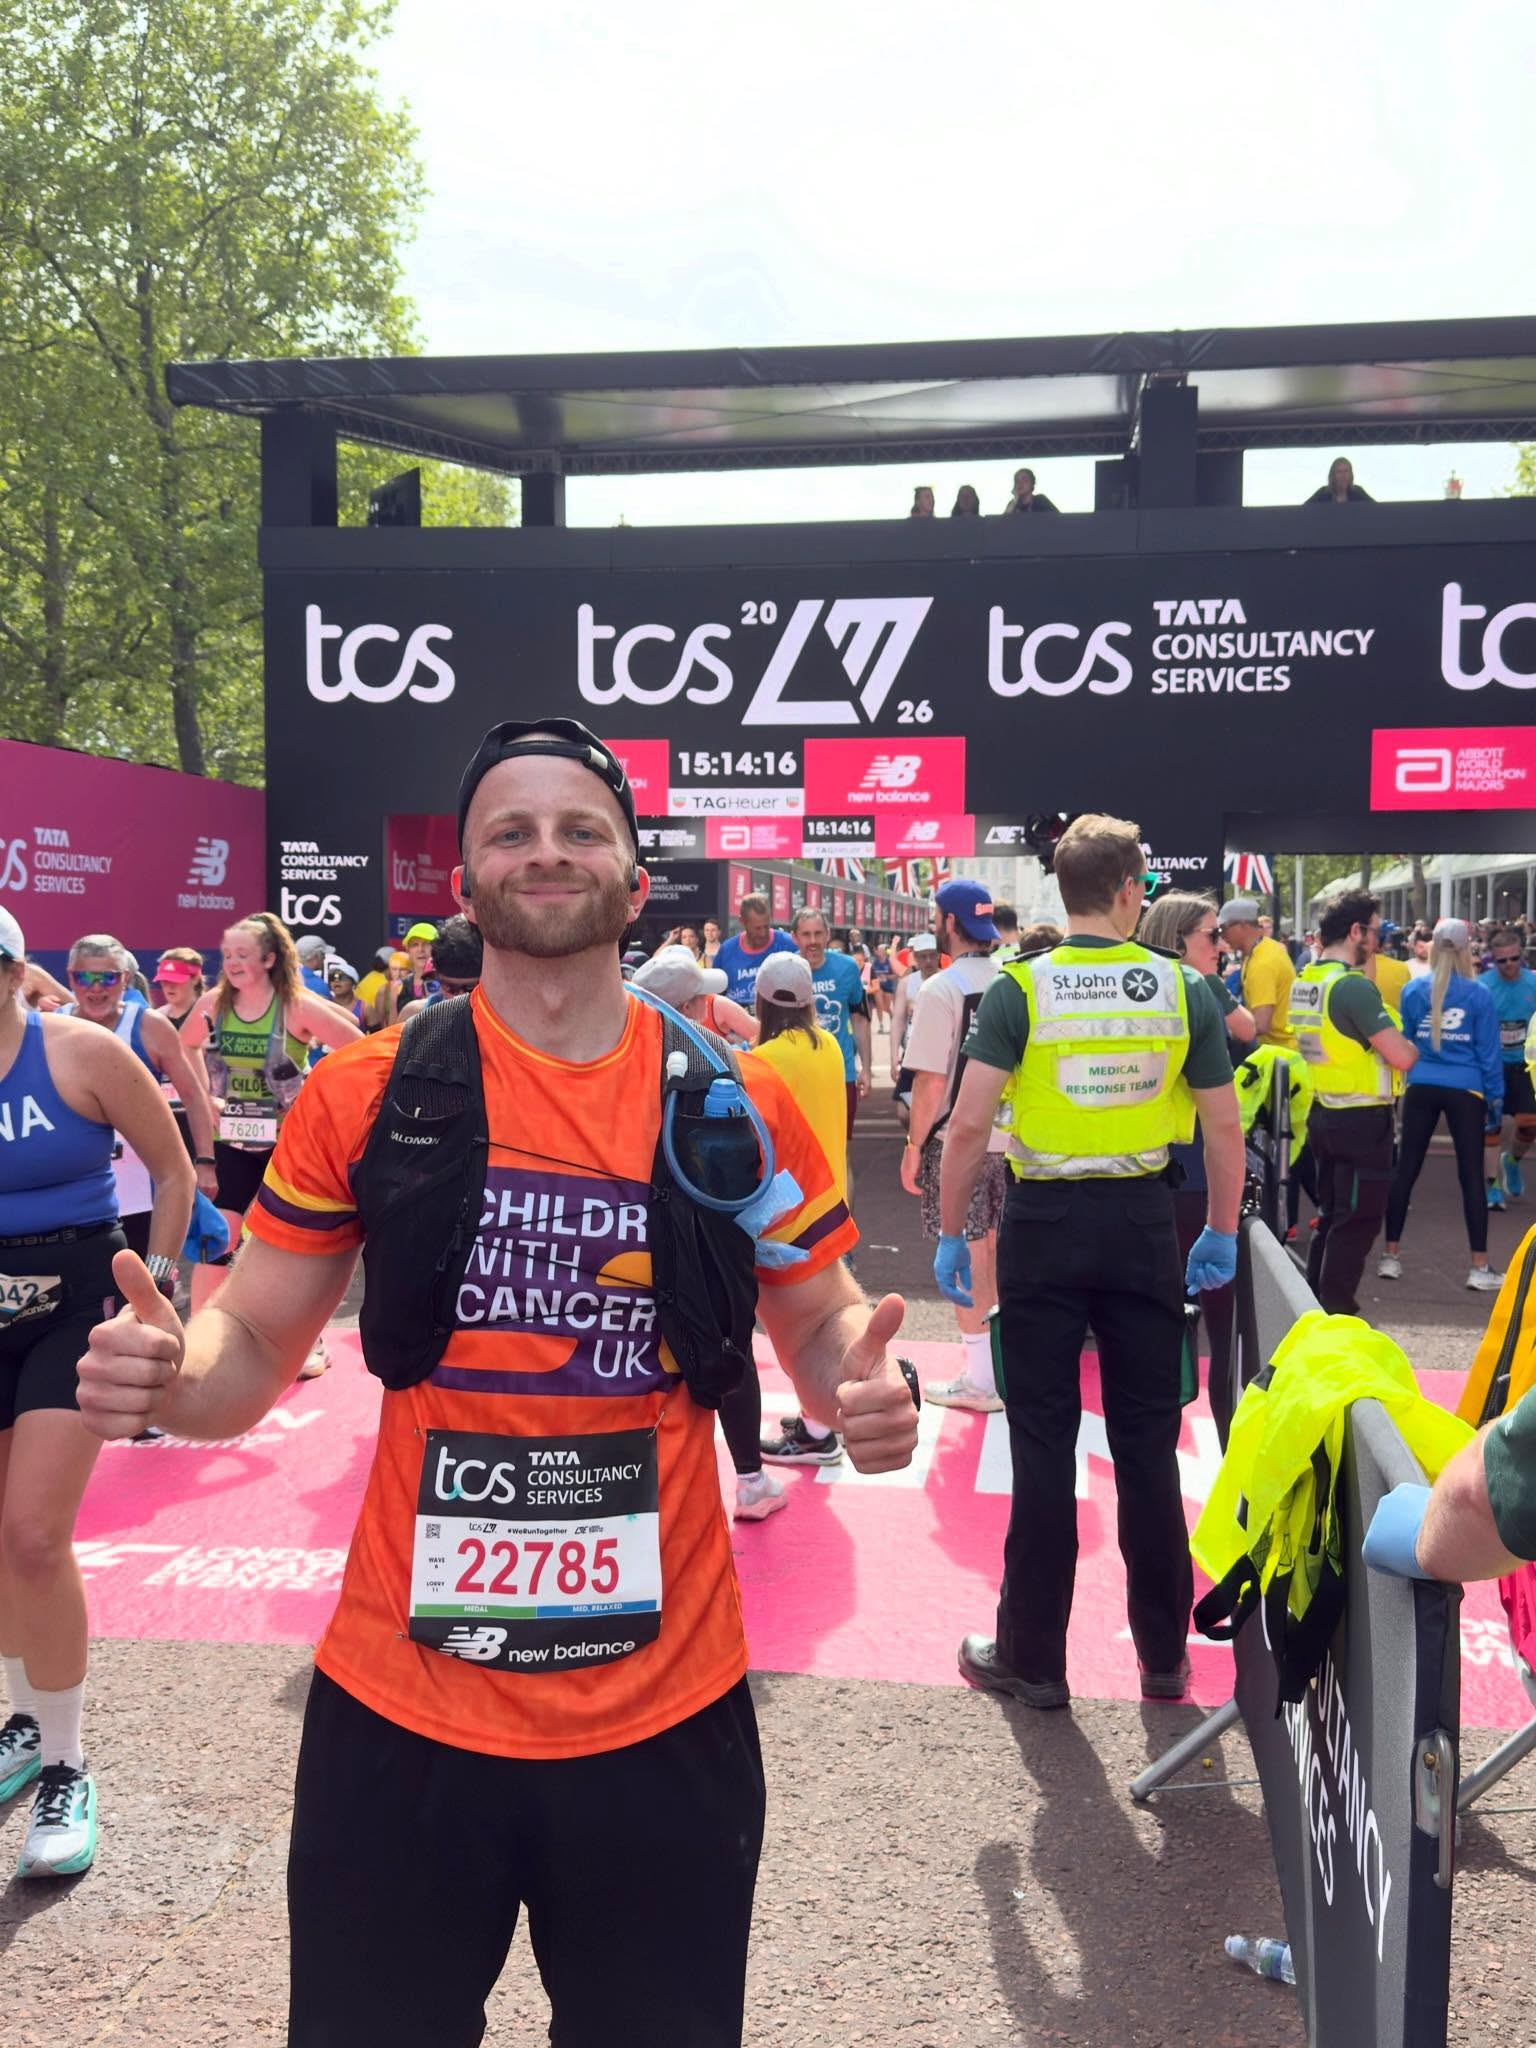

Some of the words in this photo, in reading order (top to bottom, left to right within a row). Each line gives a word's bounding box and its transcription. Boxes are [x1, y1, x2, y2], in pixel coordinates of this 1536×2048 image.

[741, 601, 778, 625] 20
[1152, 599, 1247, 626] TATA
[1152, 628, 1375, 661] CONSULTANCY
[1441, 582, 1536, 690] tc
[305, 603, 456, 703] tcs
[578, 603, 733, 705] tcs
[988, 605, 1133, 697] tcs
[1151, 665, 1291, 694] SERVICES
[898, 701, 934, 724] 26
[1456, 747, 1505, 759] ABBOTT
[678, 751, 798, 776] 15:14:16
[1456, 759, 1503, 769] WORLD
[1456, 769, 1526, 780] MARATHON
[1456, 780, 1505, 791] MAJORS
[847, 791, 874, 803] new
[876, 790, 931, 803] balance
[34, 827, 70, 848] TATA
[807, 820, 872, 836] 15:14:16
[280, 841, 319, 853] TATA
[34, 851, 112, 874] CONSULTANCY
[280, 854, 370, 868] CONSULTANCY
[1146, 856, 1209, 871] ULTANCY
[280, 868, 338, 881] SERVICES
[650, 875, 669, 884] ATA
[34, 874, 86, 895] SERVICES
[650, 883, 700, 892] ONSULTANCY
[177, 893, 197, 908] new
[280, 885, 342, 927] tcs
[737, 967, 758, 981] JAM
[1053, 974, 1072, 989] St
[1074, 973, 1117, 989] John
[1055, 989, 1118, 1001] Ambulance
[1088, 1064, 1141, 1077] MEDICAL
[1066, 1083, 1127, 1095] RESPONSE
[1128, 1079, 1158, 1092] TEAM
[229, 1122, 266, 1138] 76201
[478, 1188, 649, 1243] CHILDR
[464, 1235, 582, 1283] WITH
[455, 1283, 657, 1332] CANCER
[593, 1338, 654, 1379] UK
[527, 1450, 581, 1467] TATA
[434, 1446, 517, 1505] tcs
[526, 1463, 643, 1487] CONSULTANCY
[526, 1487, 604, 1506] SERVICES
[507, 1527, 568, 1536] #WeRunTogether
[180, 1545, 348, 1561] LONDO
[454, 1537, 620, 1596] 22785
[463, 1604, 489, 1613] MEDAL
[591, 1602, 623, 1611] RELAXED
[508, 1647, 550, 1664] new
[554, 1639, 636, 1661] balance
[1283, 1699, 1337, 1907] ERVICES
[1317, 1648, 1393, 1964] ULTANCY
